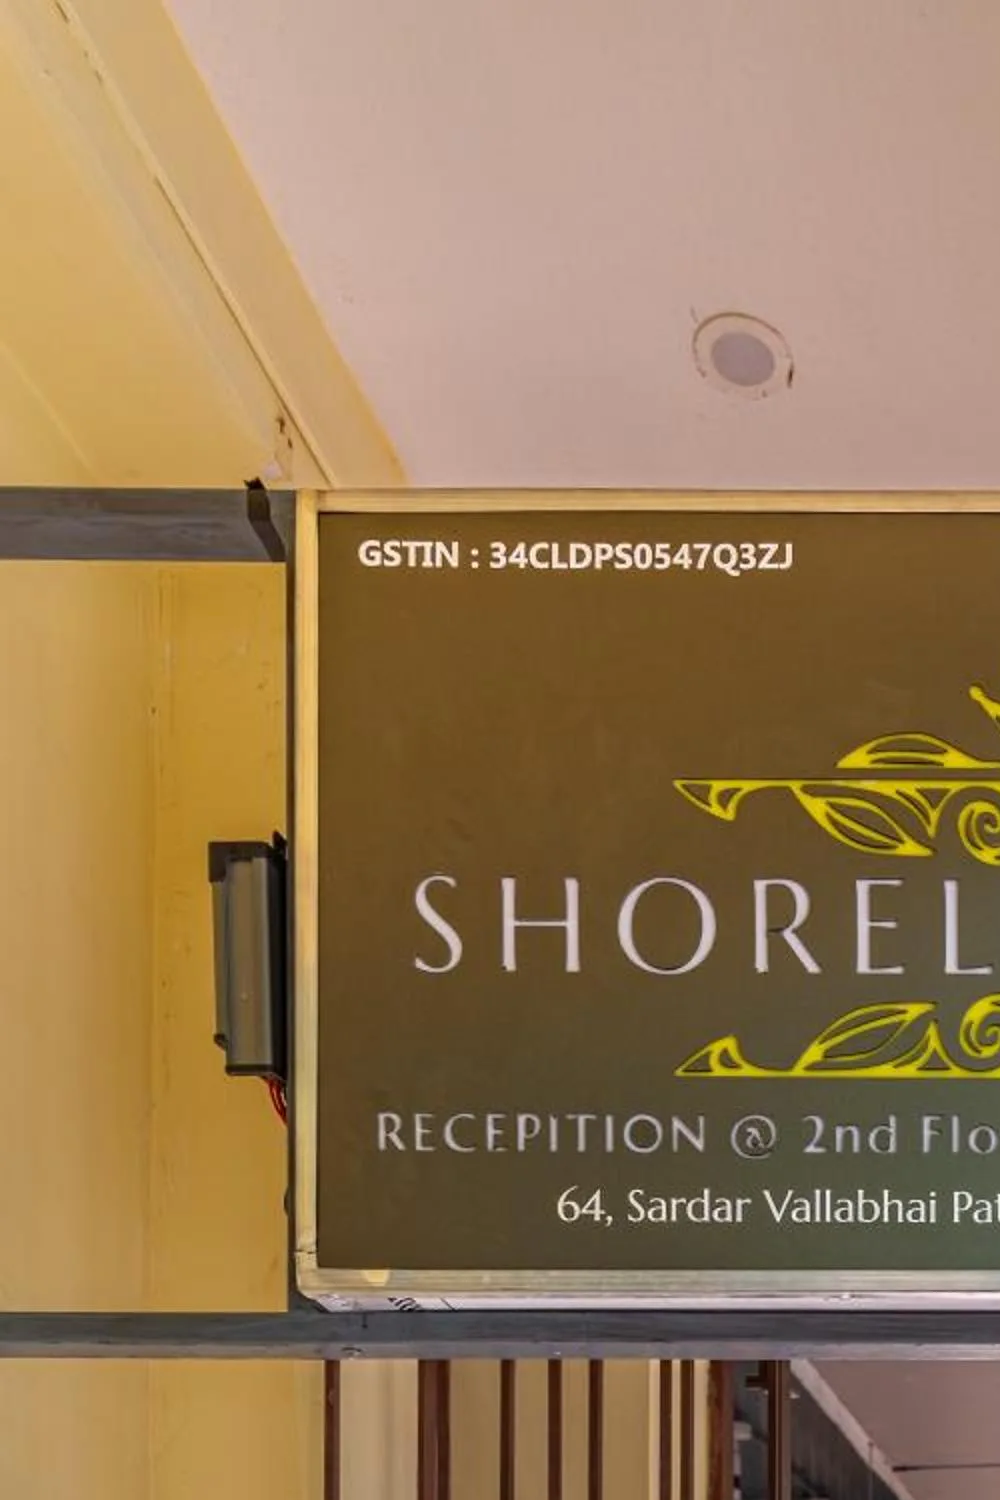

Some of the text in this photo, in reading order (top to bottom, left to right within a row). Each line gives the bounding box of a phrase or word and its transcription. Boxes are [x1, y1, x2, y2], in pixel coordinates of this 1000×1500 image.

[358, 539, 459, 568] GSTIN
[377, 1113, 705, 1154] RECEPITION
[731, 1114, 777, 1159] @
[804, 1115, 898, 1155] 2nd
[556, 1185, 613, 1228] 64,
[627, 1190, 751, 1224] Sardar
[764, 1190, 937, 1224] Vallabhai
